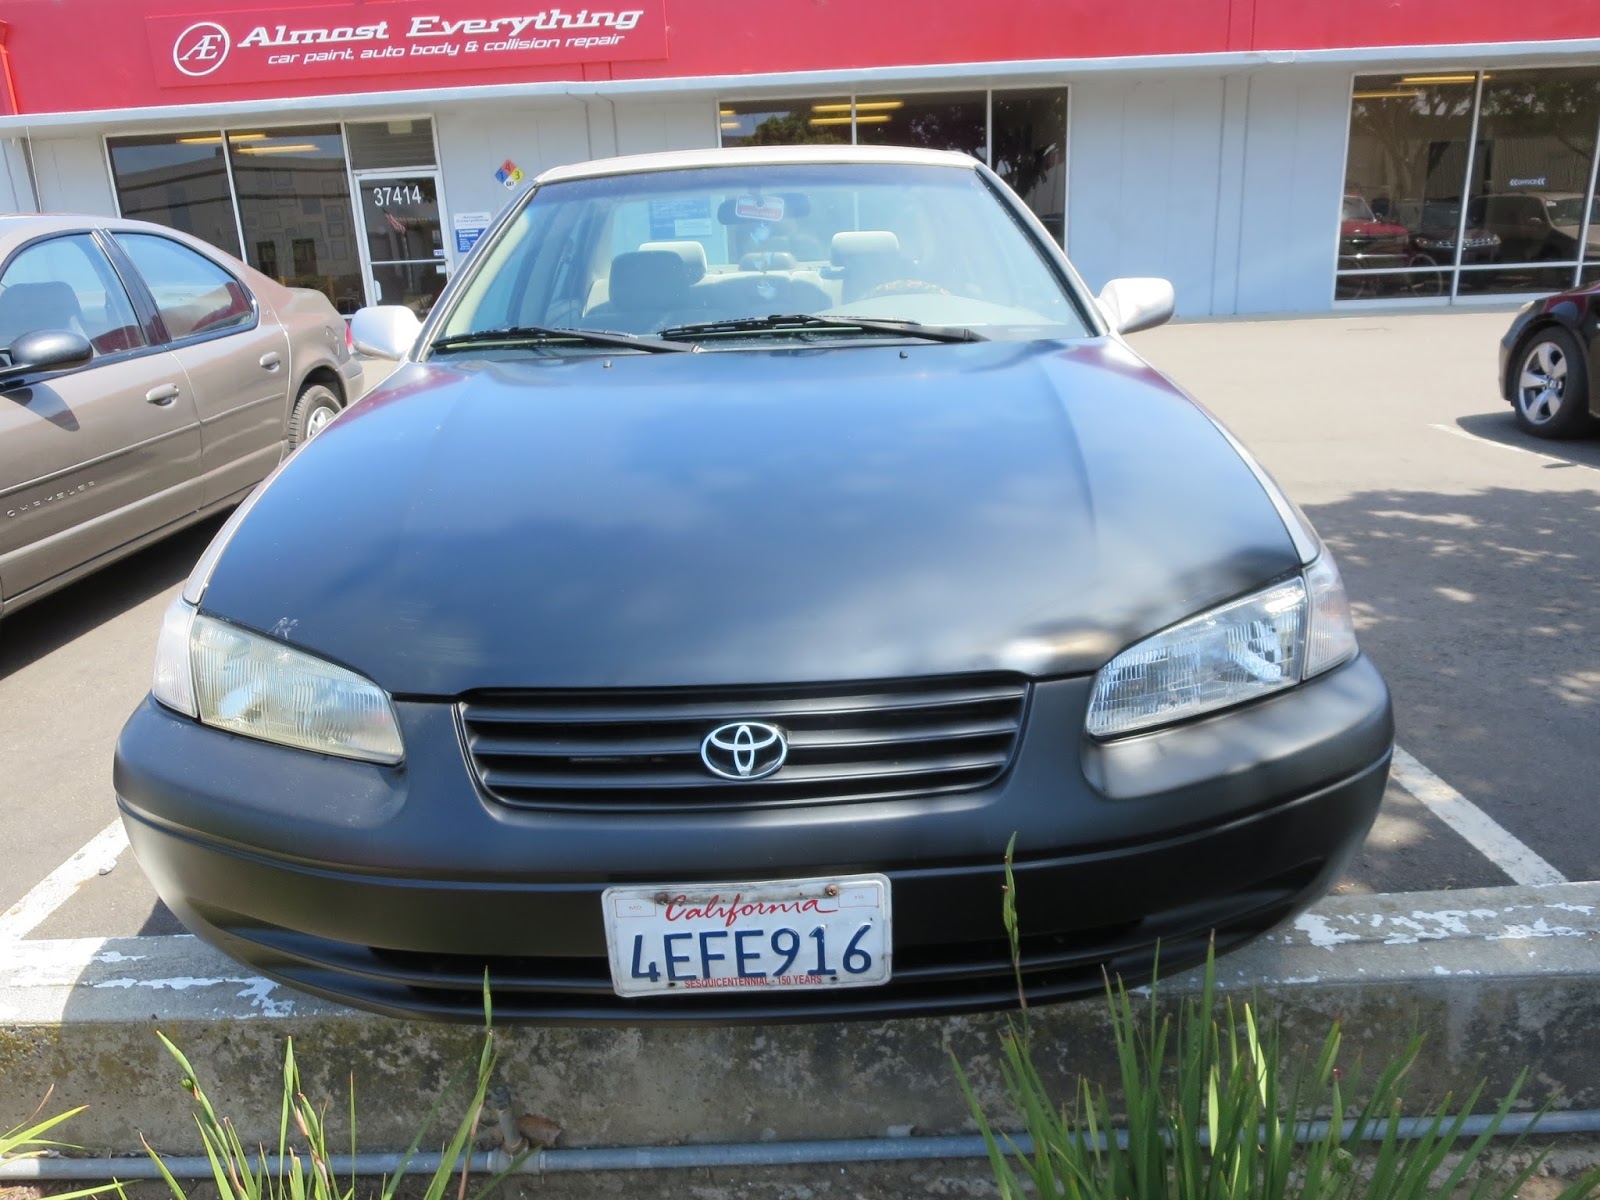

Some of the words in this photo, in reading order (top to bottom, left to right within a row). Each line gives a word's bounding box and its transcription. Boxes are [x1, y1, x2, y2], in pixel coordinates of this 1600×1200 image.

[237, 21, 390, 48] Almost
[406, 9, 644, 37] Everything
[267, 53, 301, 65] car
[360, 45, 405, 60] auto
[410, 41, 460, 57] body
[465, 40, 479, 53] &
[483, 38, 561, 52] collision
[565, 33, 625, 48] repair
[504, 162, 511, 172] 4
[514, 170, 521, 180] 3
[374, 185, 421, 207] 37414
[665, 893, 838, 927] California
[631, 924, 872, 982] 4EFE916
[685, 976, 769, 988] SESQUICENTENNIAL
[777, 975, 791, 985] 150
[792, 974, 822, 985] YEARS
